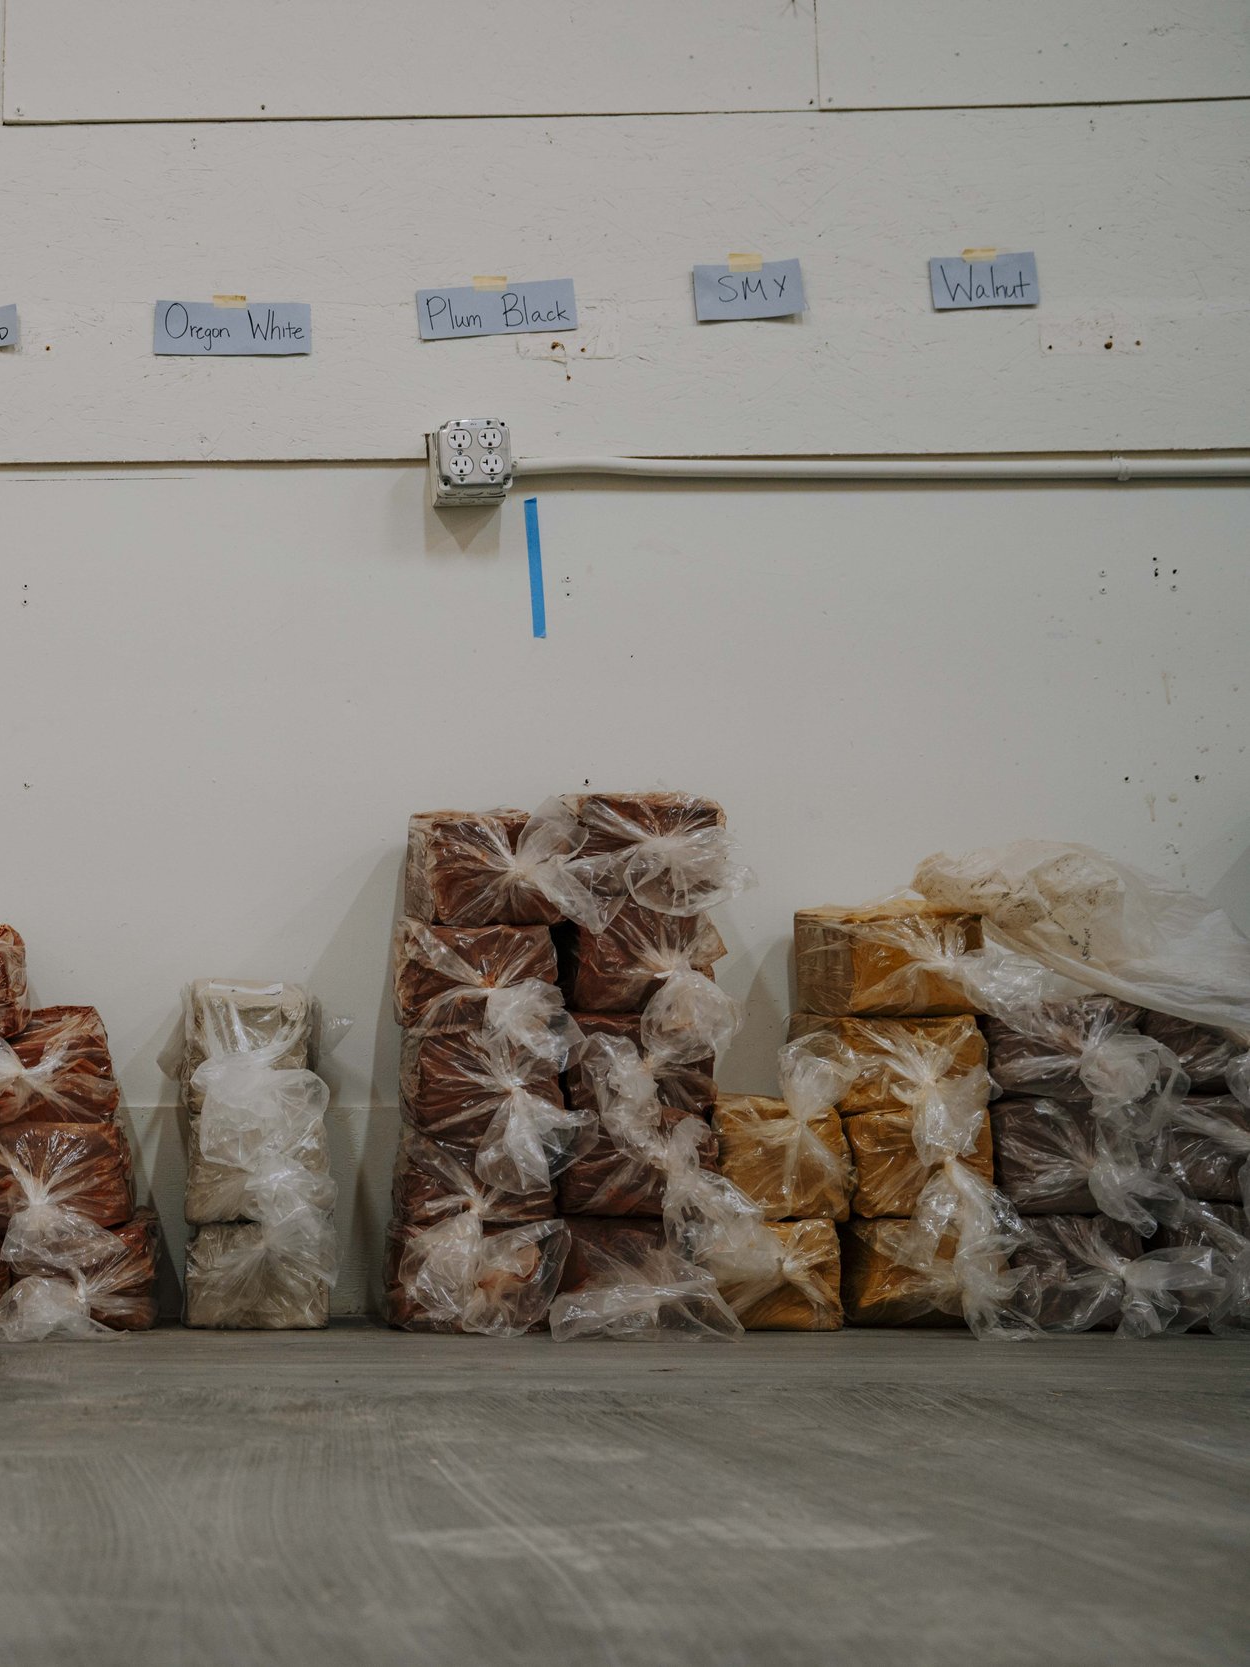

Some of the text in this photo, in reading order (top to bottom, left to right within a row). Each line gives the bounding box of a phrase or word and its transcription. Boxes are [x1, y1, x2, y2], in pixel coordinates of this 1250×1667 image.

[939, 264, 1031, 302] Walnut
[164, 303, 305, 350] Oregon White
[426, 293, 570, 330] Plum Black
